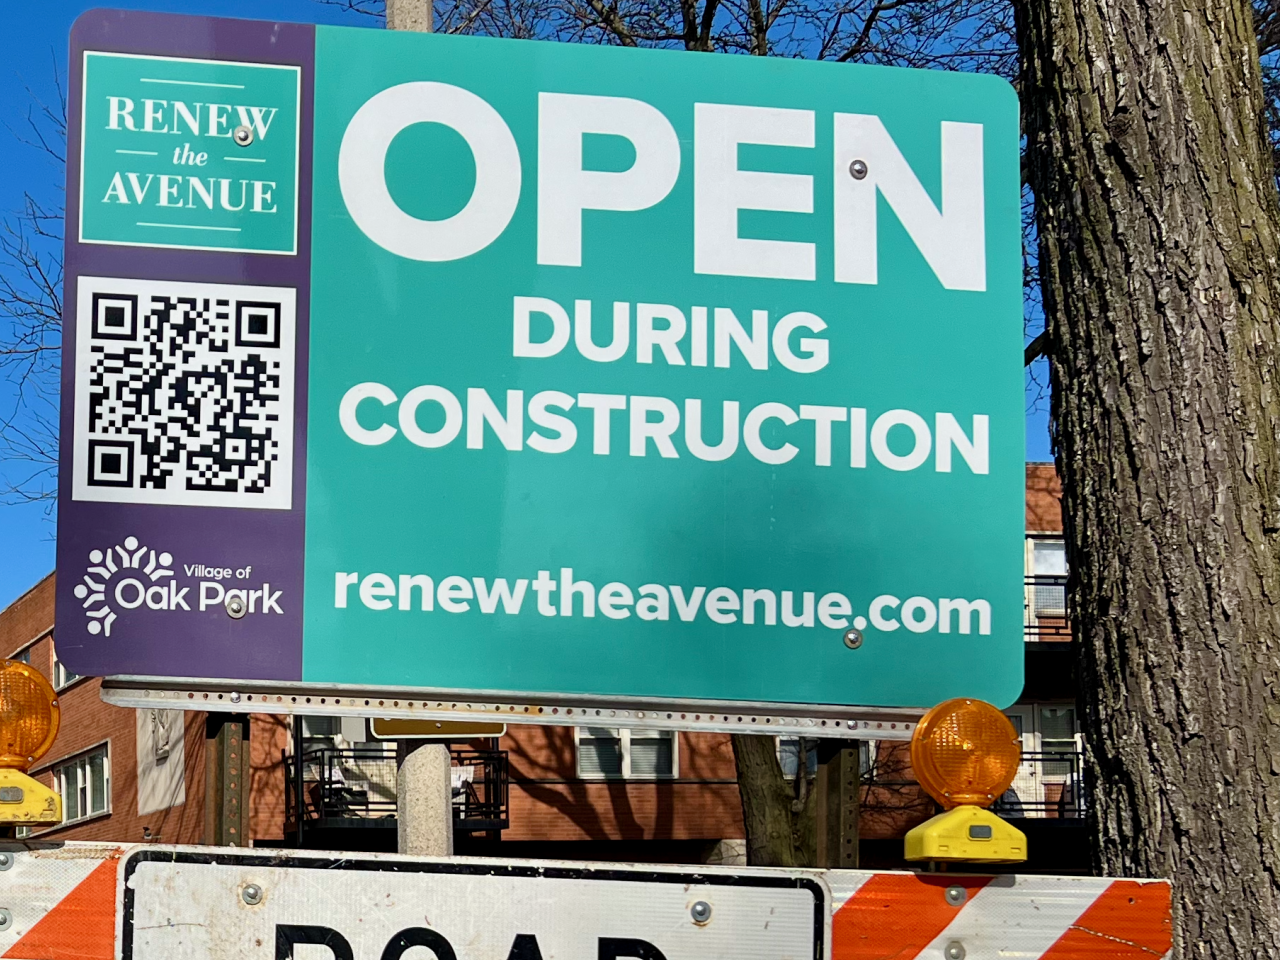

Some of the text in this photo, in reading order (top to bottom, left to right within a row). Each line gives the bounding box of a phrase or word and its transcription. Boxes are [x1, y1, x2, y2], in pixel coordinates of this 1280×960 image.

[105, 96, 278, 140] RENEW
[173, 143, 208, 166] the
[101, 172, 277, 213] AVENUE
[338, 81, 986, 292] OPEN
[513, 295, 829, 374] DURING
[339, 381, 989, 475] CONSTRUCTION
[183, 564, 252, 580] Village of
[115, 578, 284, 615] Oak Park
[334, 567, 991, 636] renewtheavenue.com
